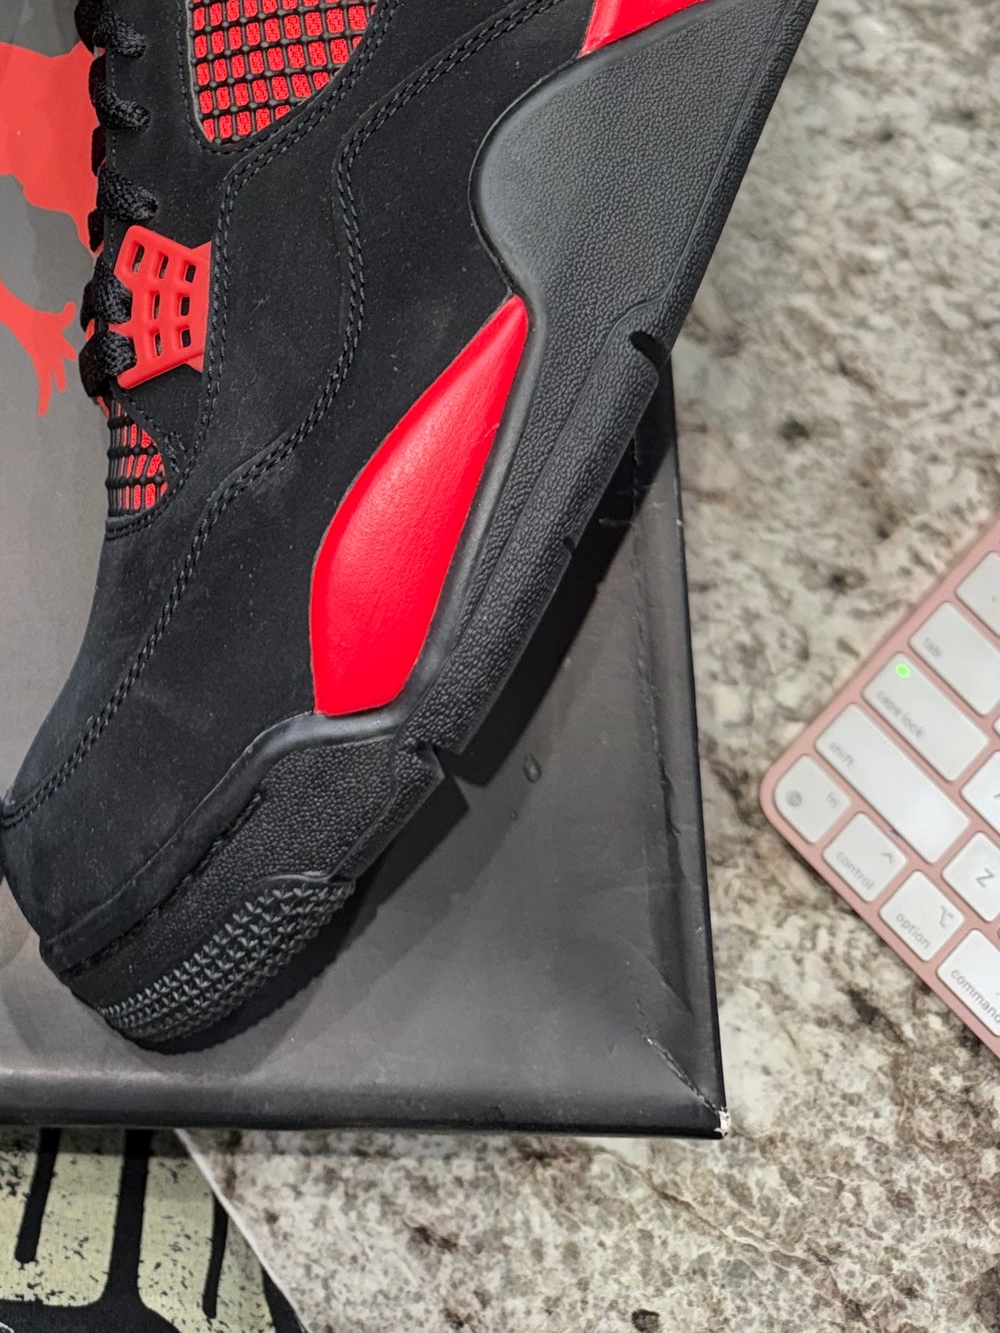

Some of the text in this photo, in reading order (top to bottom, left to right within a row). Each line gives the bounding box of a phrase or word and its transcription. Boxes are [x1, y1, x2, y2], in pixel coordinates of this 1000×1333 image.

[923, 637, 942, 658] tab
[876, 690, 924, 739] caps lock
[829, 741, 855, 767] shift
[825, 792, 839, 808] fn
[835, 851, 875, 890] control
[975, 867, 995, 888] Z
[895, 913, 931, 949] option
